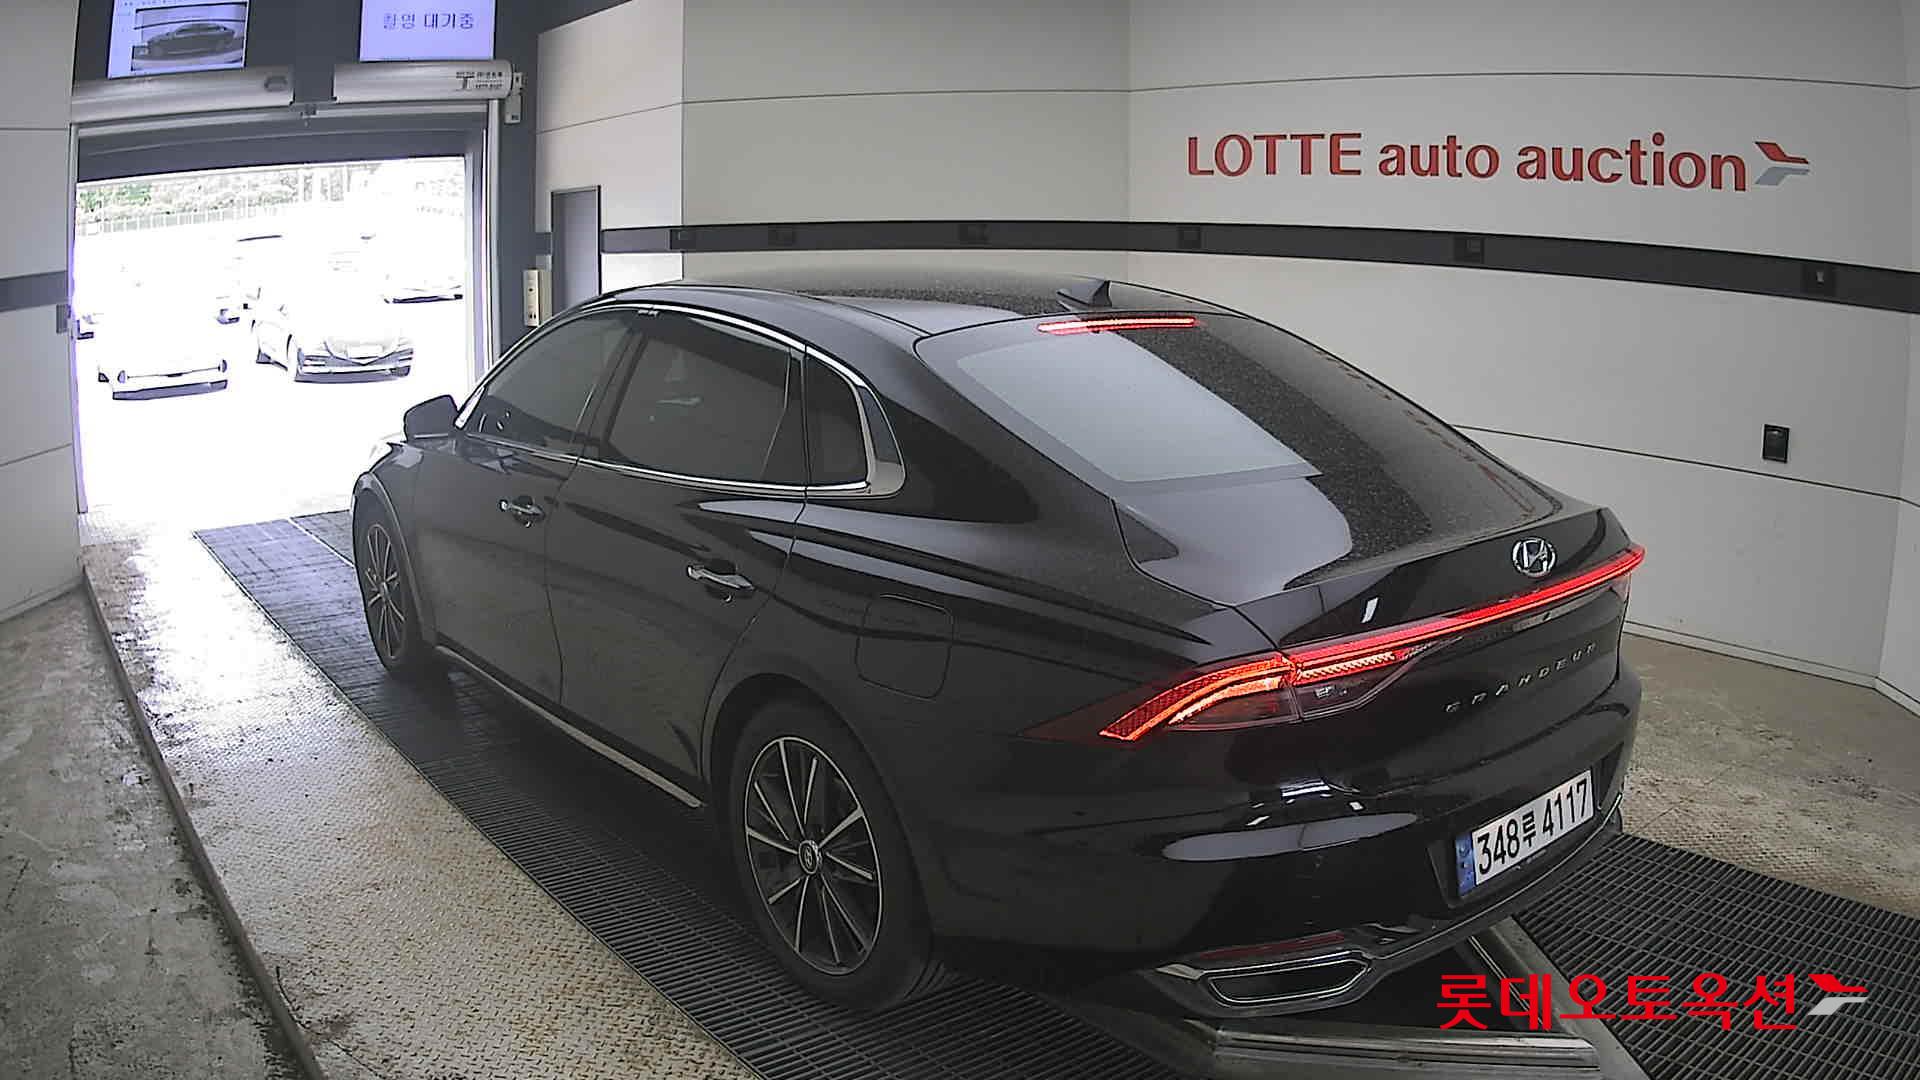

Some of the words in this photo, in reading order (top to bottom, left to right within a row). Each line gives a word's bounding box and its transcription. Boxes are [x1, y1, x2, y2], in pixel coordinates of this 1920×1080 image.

[423, 12, 474, 30] 대기중
[1187, 132, 1362, 177] LOTTE
[1378, 134, 1500, 179] auto
[1516, 131, 1747, 192] auction
[1476, 810, 1537, 876] 348루
[1542, 777, 1588, 837] 4117
